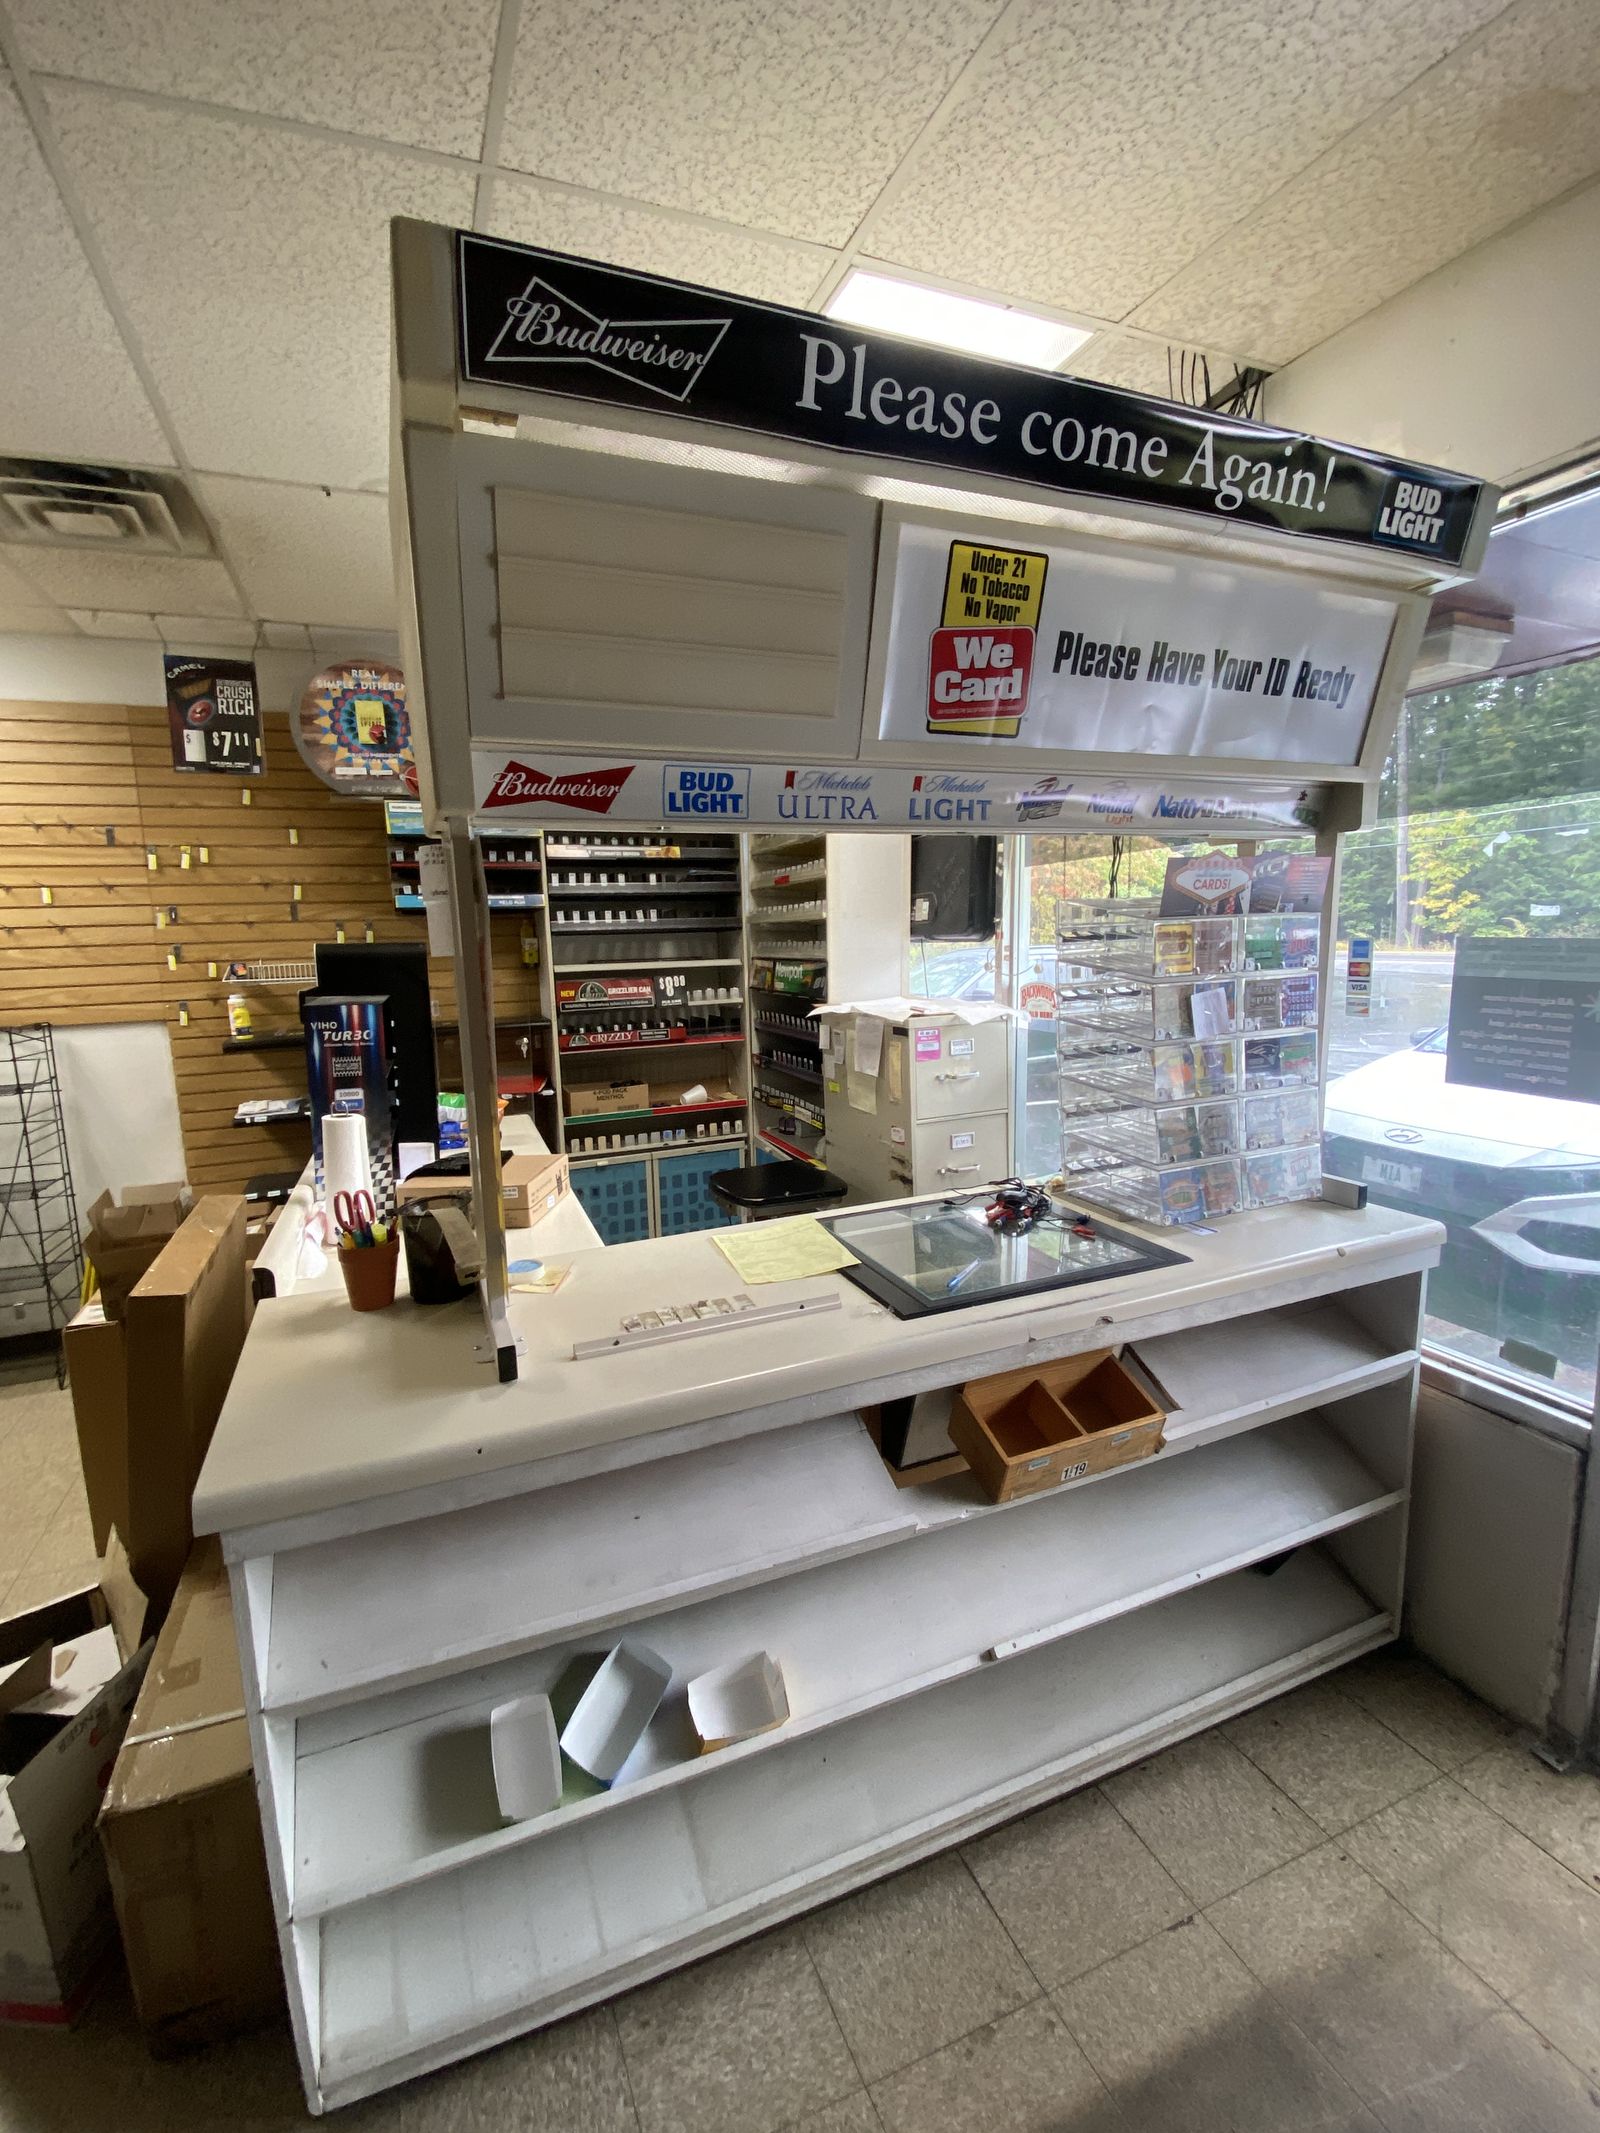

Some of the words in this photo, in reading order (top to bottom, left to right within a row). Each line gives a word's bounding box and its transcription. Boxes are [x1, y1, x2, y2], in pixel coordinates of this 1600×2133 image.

[506, 296, 706, 373] Budweiser
[795, 333, 1001, 446] Please
[1020, 409, 1169, 479] come
[1179, 427, 1337, 512] Again!
[1394, 481, 1441, 515] BUD
[1378, 506, 1445, 544] LIGHT
[971, 550, 1008, 576] Under
[1012, 557, 1027, 578] 21
[960, 572, 977, 594] No
[981, 576, 1030, 602] Tobacco
[964, 596, 982, 618] No
[986, 599, 1021, 624] Vapor
[953, 636, 1014, 669] We
[167, 663, 206, 679] CAMEL
[1052, 630, 1141, 681] Please
[1146, 641, 1205, 687] Have
[1211, 648, 1262, 693] Your
[1262, 657, 1290, 697] ID
[1291, 660, 1355, 710] Ready
[216, 686, 253, 699] CRUSH
[934, 668, 1024, 704] Card
[217, 698, 255, 716] RICH
[493, 772, 622, 798] Budweiser
[680, 771, 734, 792] BUD
[799, 771, 872, 793] Michelob
[924, 775, 986, 794] Michelob
[668, 792, 743, 814] LIGHT
[777, 795, 878, 821] ULTRA
[908, 797, 992, 822] LIGHT
[1018, 803, 1062, 822] ICE
[1105, 814, 1134, 825] Light
[1193, 879, 1231, 890] CARDS!
[776, 961, 803, 981] Newport
[561, 989, 575, 998] NEW
[310, 1022, 338, 1030] VIHO
[590, 1031, 634, 1043] GRIZZLY
